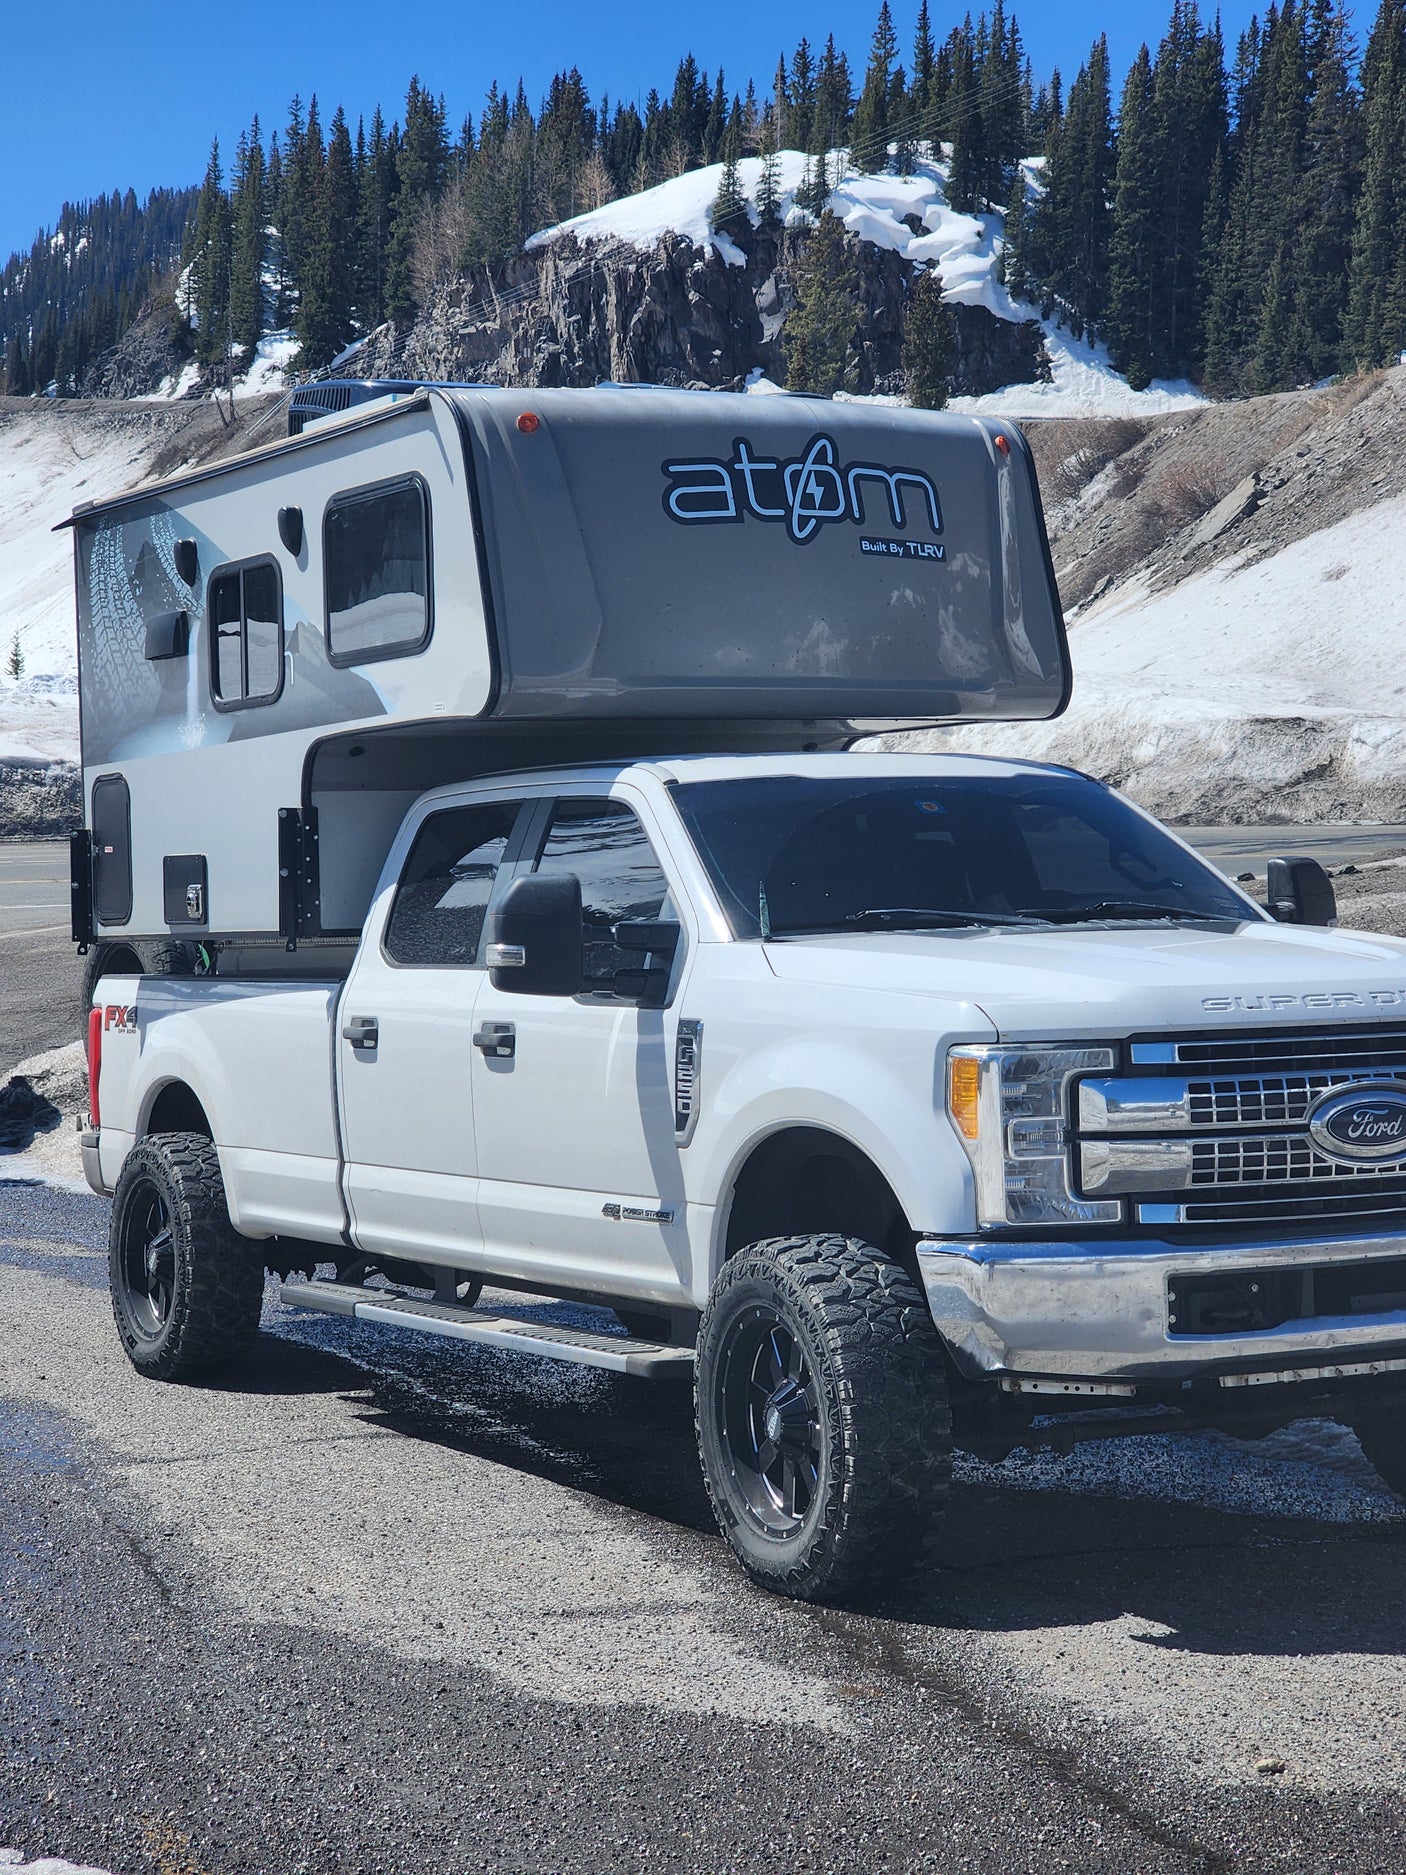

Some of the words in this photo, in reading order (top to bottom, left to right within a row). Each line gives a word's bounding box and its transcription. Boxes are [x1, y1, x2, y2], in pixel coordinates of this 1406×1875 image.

[665, 435, 942, 541] atom
[861, 540, 888, 552] Built
[889, 543, 904, 557] By
[906, 542, 944, 559] TLRV
[1201, 993, 1365, 1012] SUPER
[1368, 989, 1406, 1006] D
[104, 1005, 138, 1031] FX4
[1348, 1108, 1403, 1138] Ford
